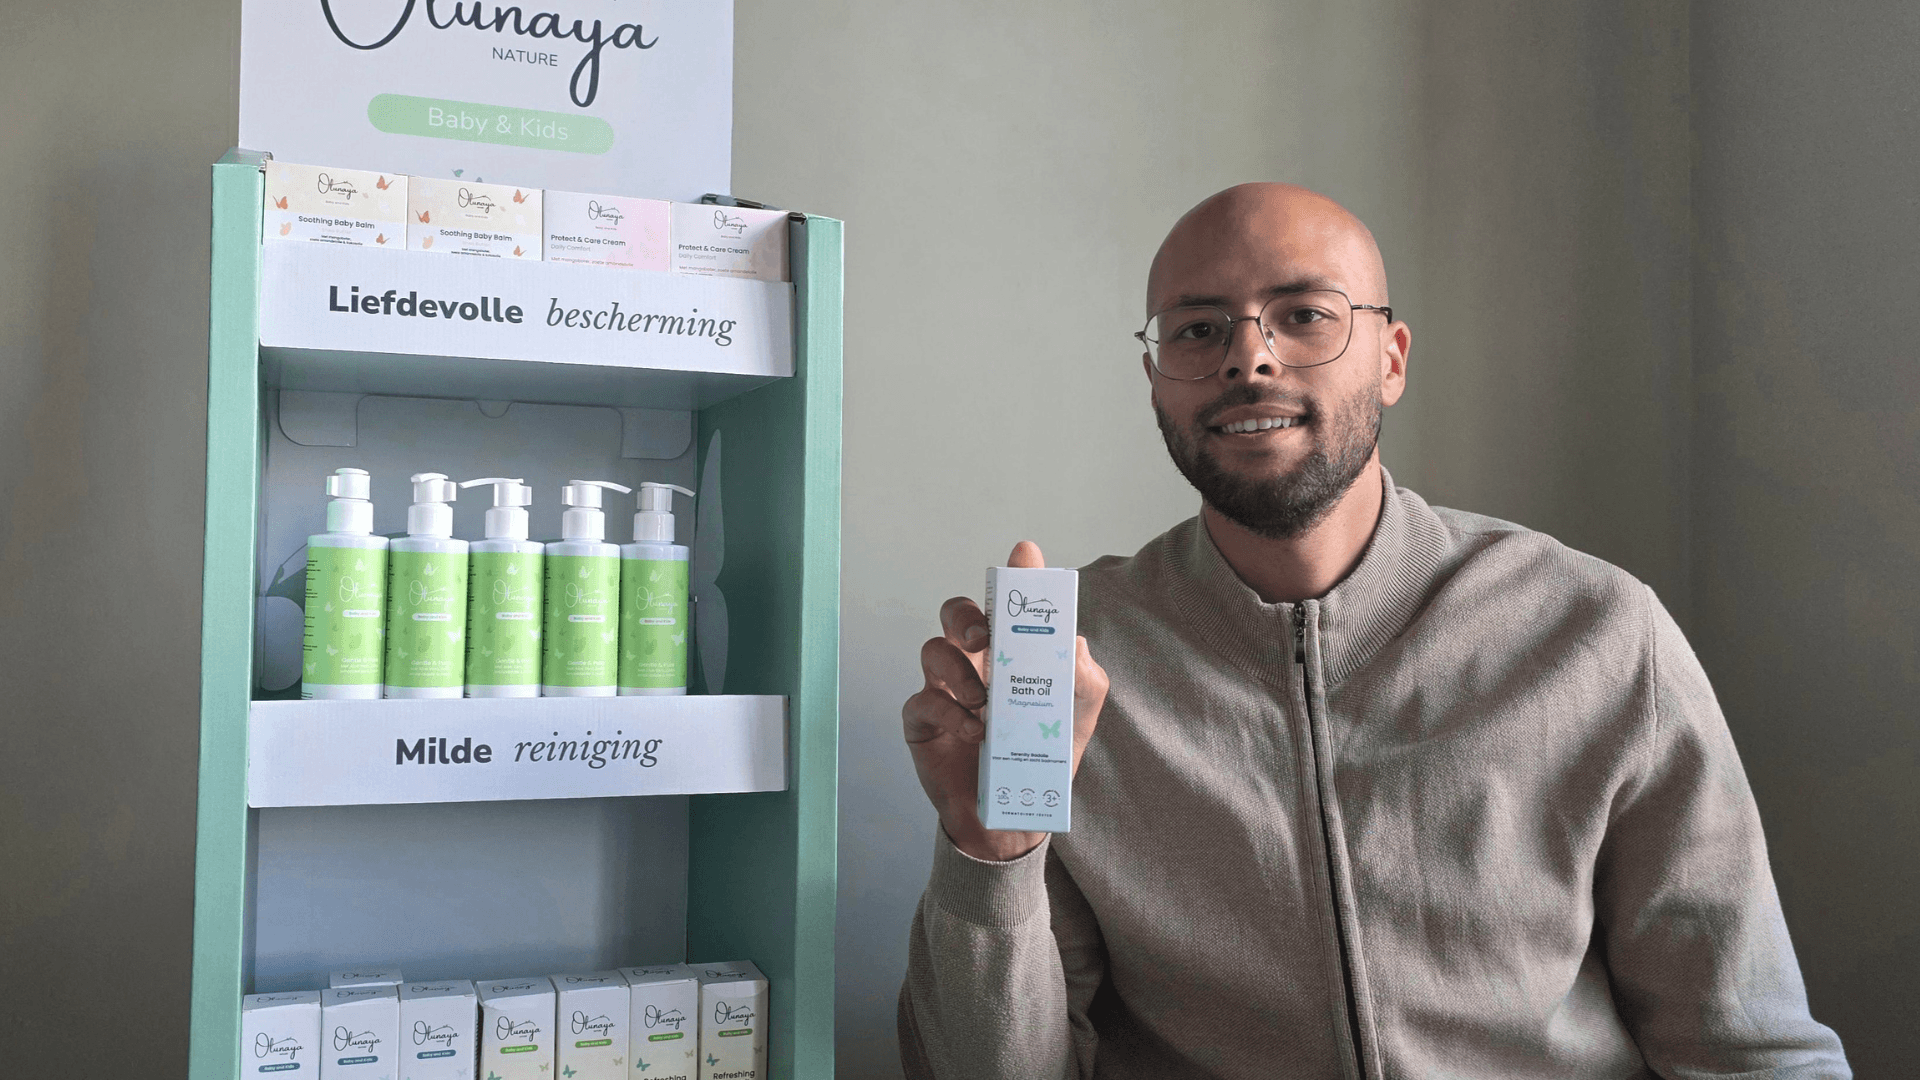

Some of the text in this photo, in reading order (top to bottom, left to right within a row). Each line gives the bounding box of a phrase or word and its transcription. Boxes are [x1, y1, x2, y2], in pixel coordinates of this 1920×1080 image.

[492, 46, 558, 67] NATURE
[428, 106, 568, 140] Baby & Kids
[298, 215, 375, 229] Soothing Baby Balm
[440, 229, 513, 242] Soothing Baby Balm
[550, 234, 576, 243] Protect
[602, 239, 626, 247] Cream
[678, 243, 703, 252] Protect
[710, 245, 727, 253] Care
[727, 247, 750, 255] Cream
[693, 253, 717, 261] Comfort
[329, 285, 737, 347] Liefdevolle bescherming
[1010, 675, 1053, 688] Relaxing
[1011, 686, 1051, 696] Bath Oil
[1007, 698, 1054, 707] Magnesium
[396, 730, 663, 769] Milde reiniging
[1046, 794, 1057, 803] 3+
[713, 1070, 755, 1080] Refreshing
